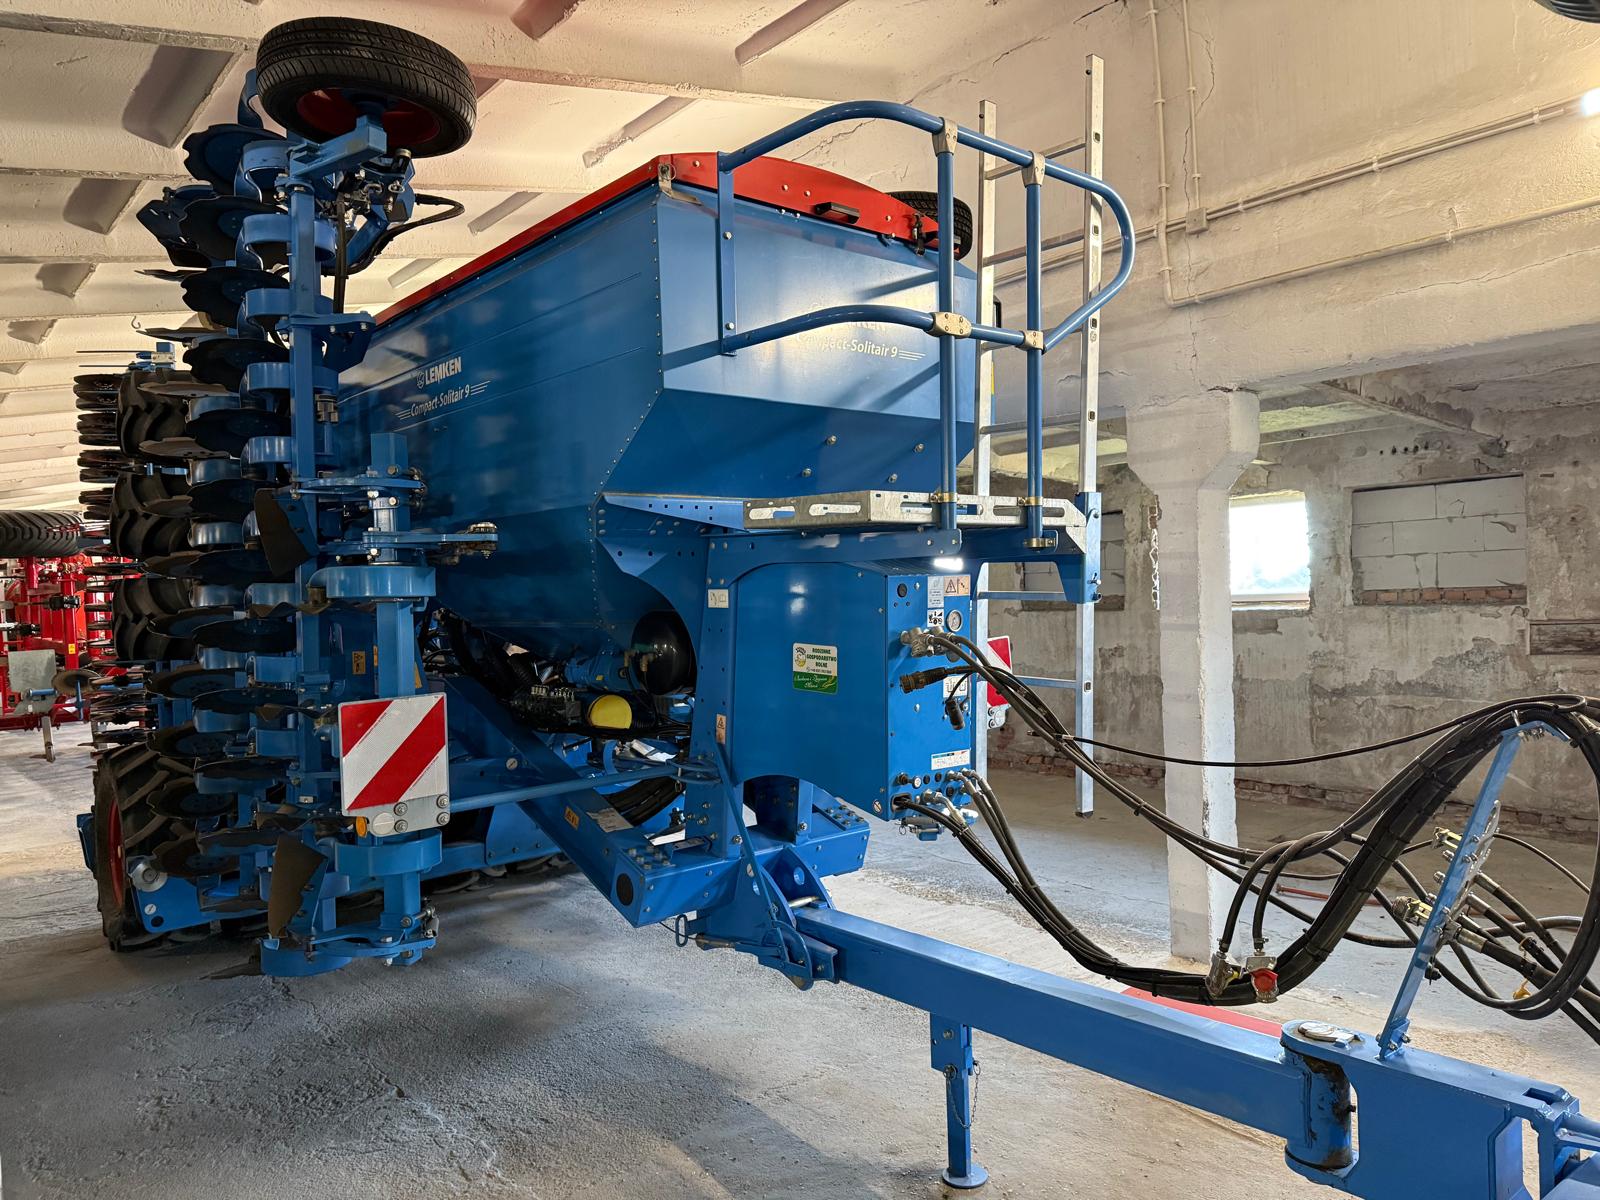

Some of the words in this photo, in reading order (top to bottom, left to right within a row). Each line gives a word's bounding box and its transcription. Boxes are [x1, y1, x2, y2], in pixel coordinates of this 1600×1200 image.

[891, 346, 898, 357] 9
[425, 357, 462, 385] LEMKEN
[410, 388, 464, 417] Compact-Solitair
[465, 384, 470, 398] 9
[806, 654, 837, 662] GOSPODARSTWO
